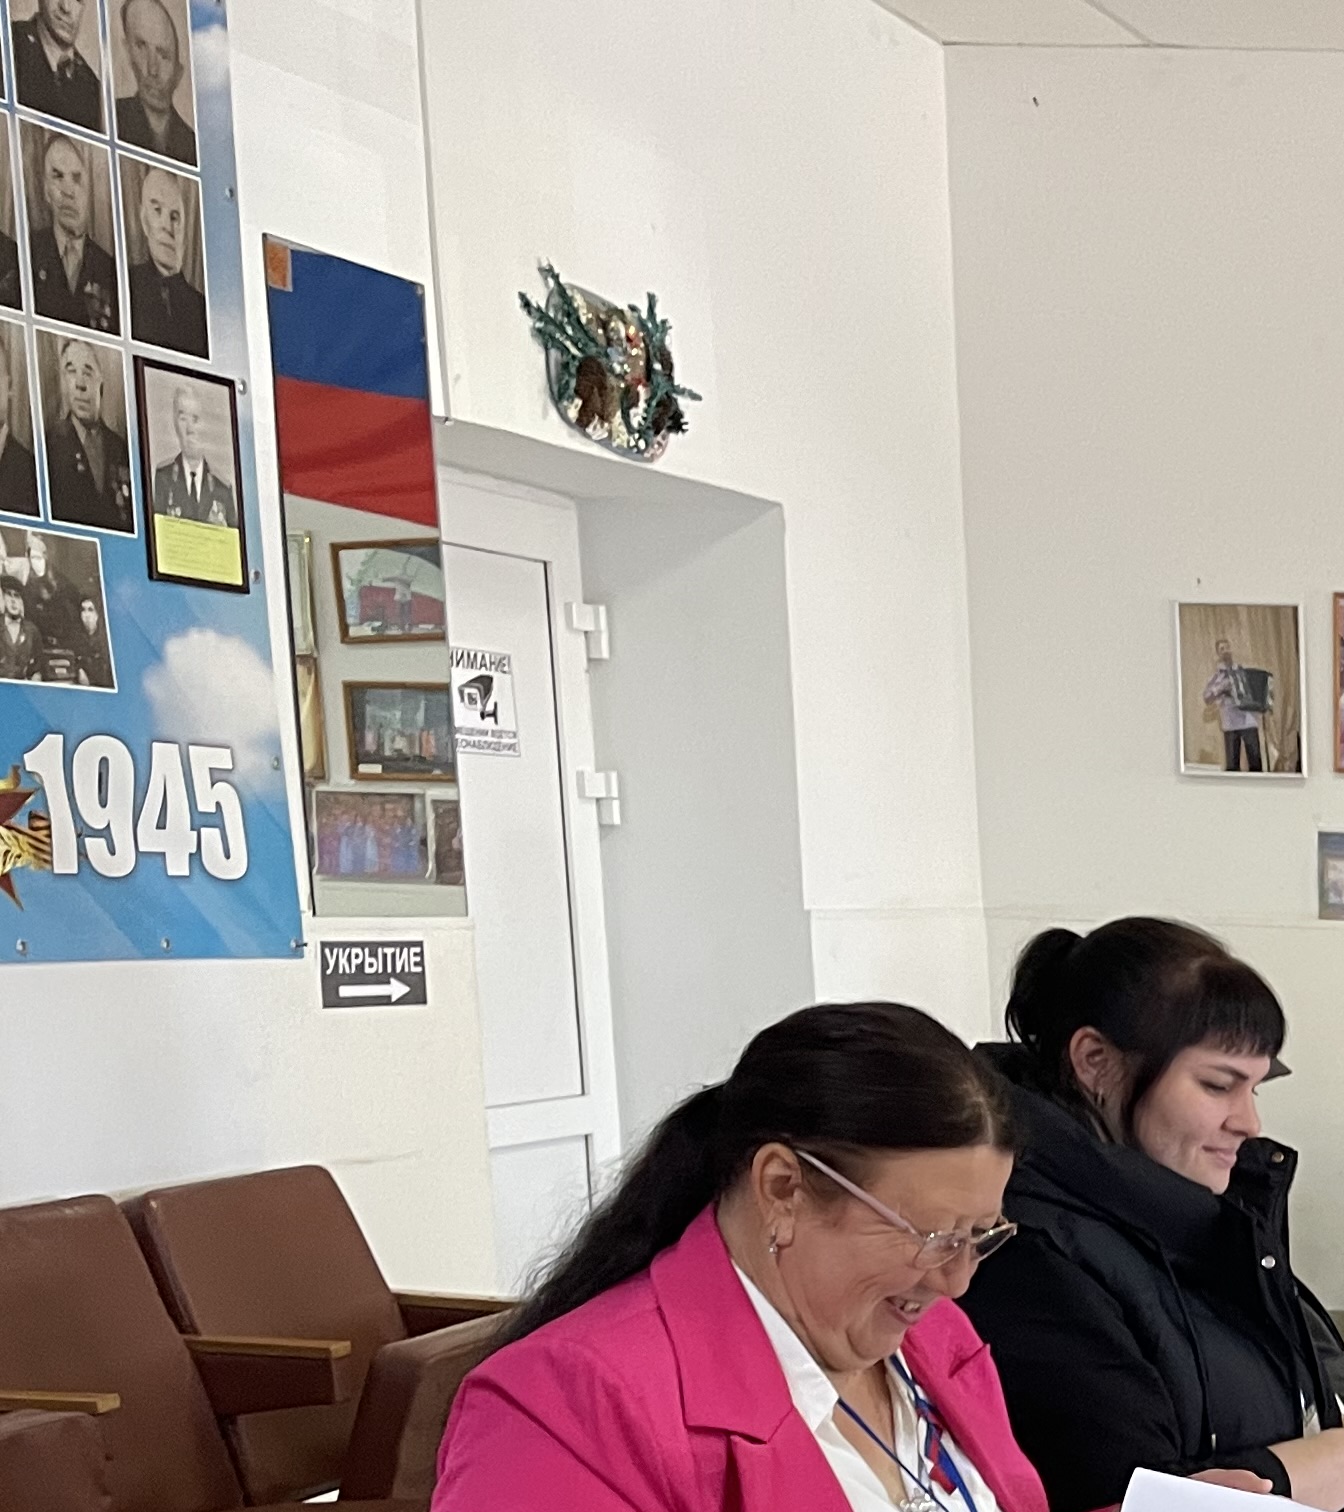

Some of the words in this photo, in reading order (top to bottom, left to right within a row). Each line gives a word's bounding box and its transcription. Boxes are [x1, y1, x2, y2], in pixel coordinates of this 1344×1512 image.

[450, 650, 511, 674] ИМАНИЕ!
[23, 734, 248, 880] 1945
[324, 947, 422, 975] УКРЫТИЕ
